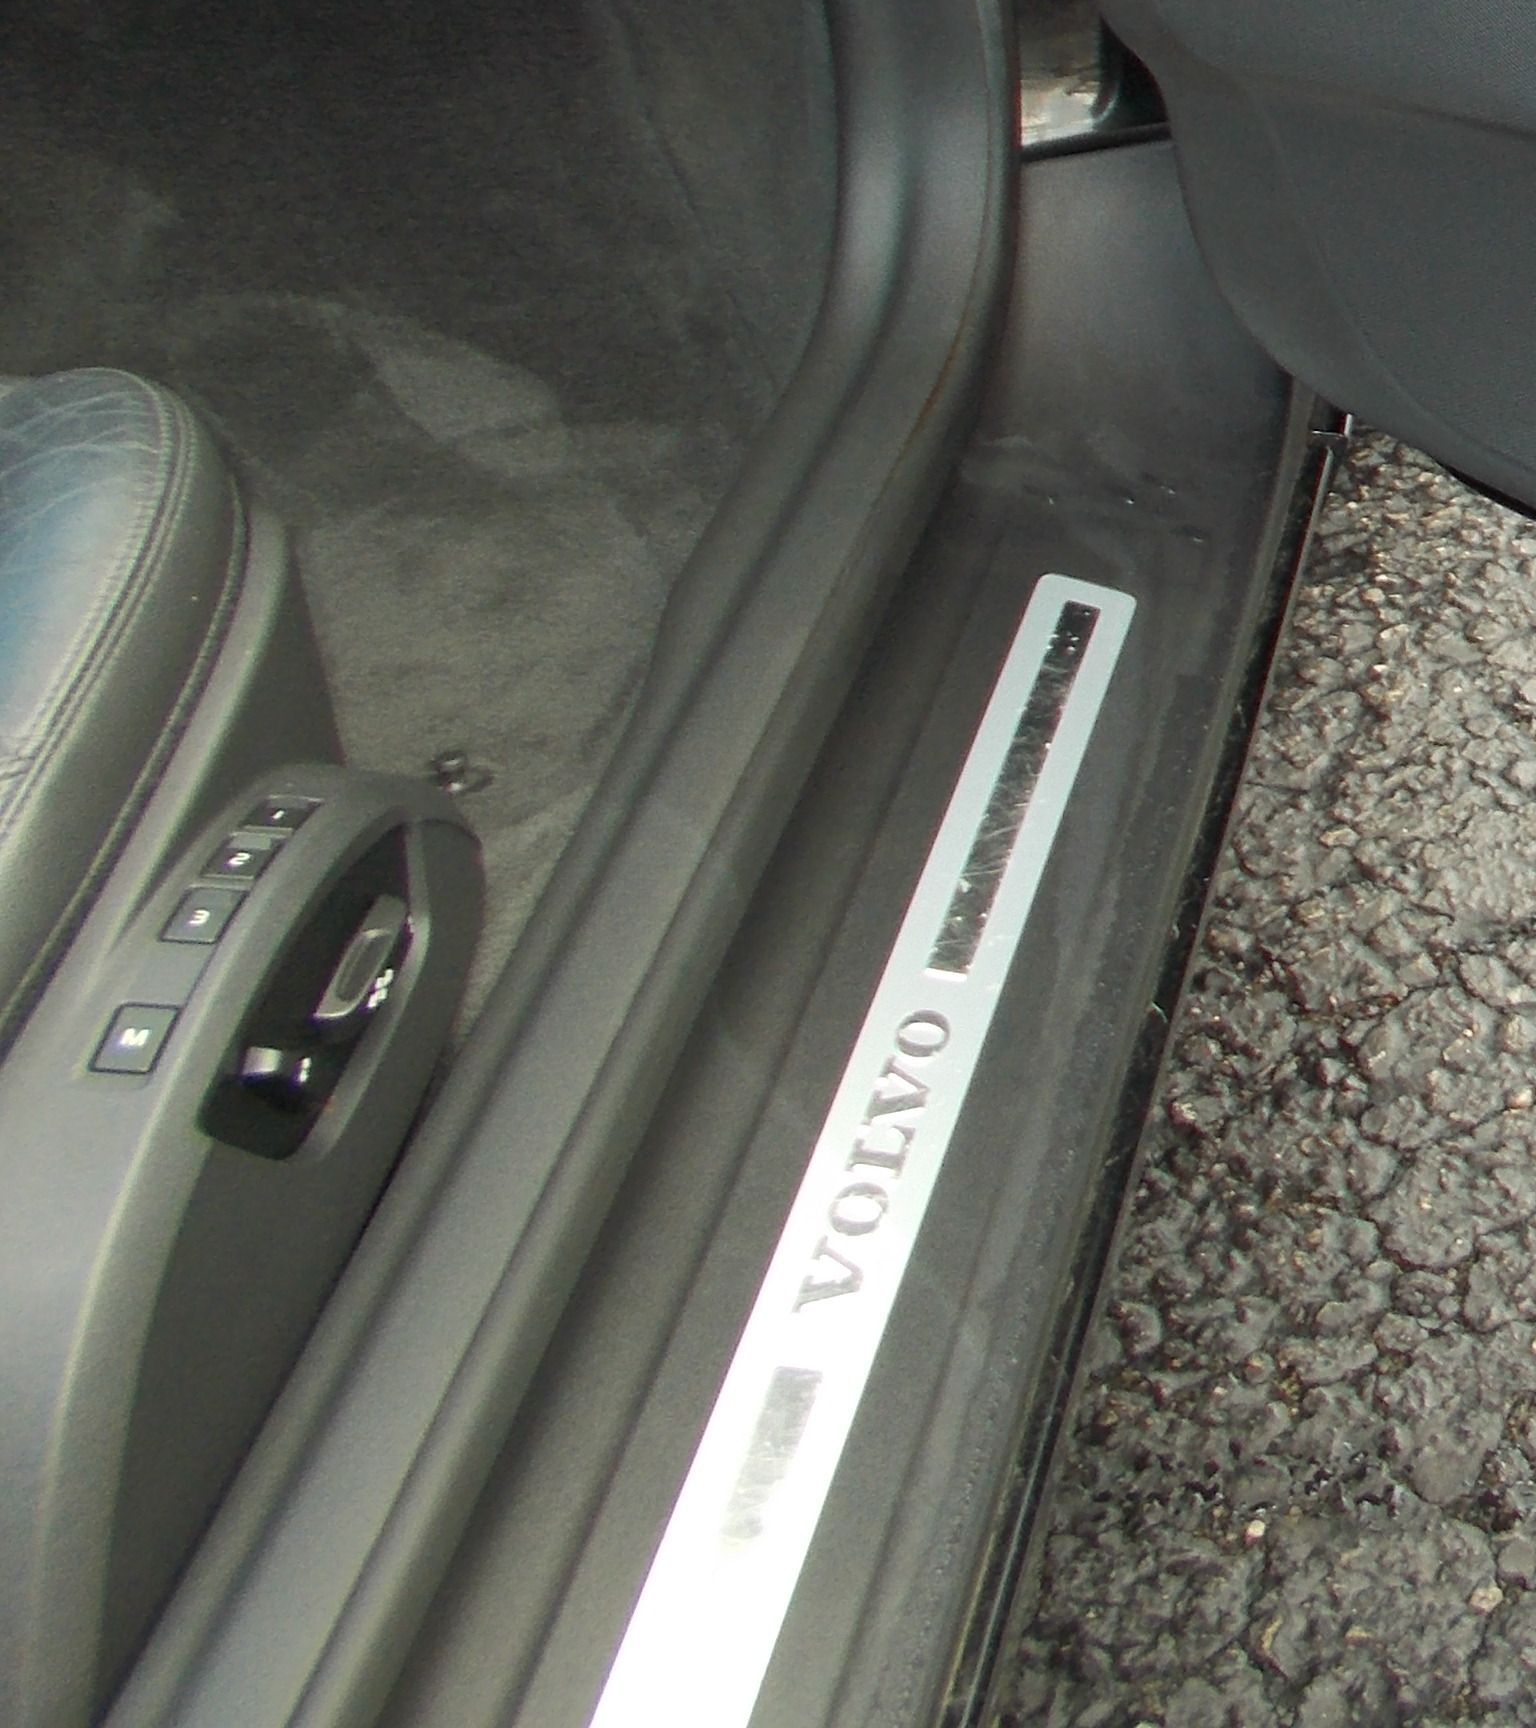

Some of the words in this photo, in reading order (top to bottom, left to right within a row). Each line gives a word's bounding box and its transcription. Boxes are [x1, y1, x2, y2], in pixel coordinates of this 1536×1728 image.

[272, 810, 285, 820] 1
[228, 852, 252, 866] 2
[190, 909, 210, 925] 3
[121, 1028, 150, 1047] M
[791, 1009, 950, 1314] VOLVO
